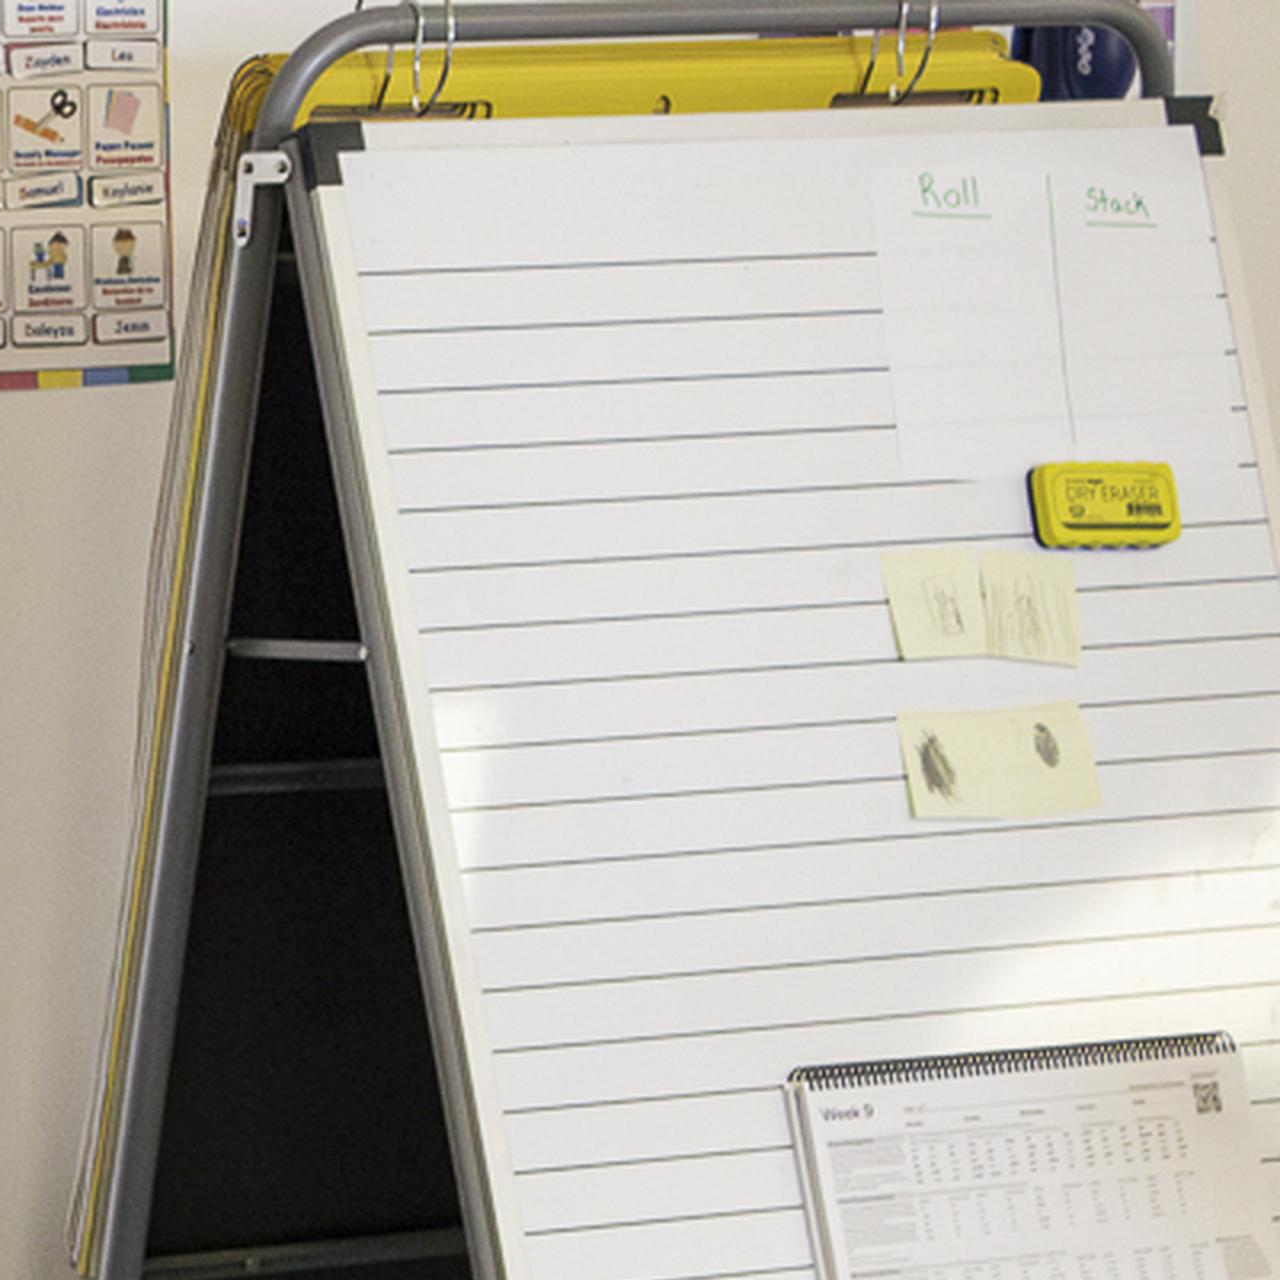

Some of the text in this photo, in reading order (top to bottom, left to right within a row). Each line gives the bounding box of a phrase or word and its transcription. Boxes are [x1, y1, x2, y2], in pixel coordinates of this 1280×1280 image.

[918, 171, 981, 209] Roll
[1085, 187, 1151, 220] Stack
[1064, 484, 1159, 503] DRY ERASER
[820, 1103, 875, 1122] Week 9
